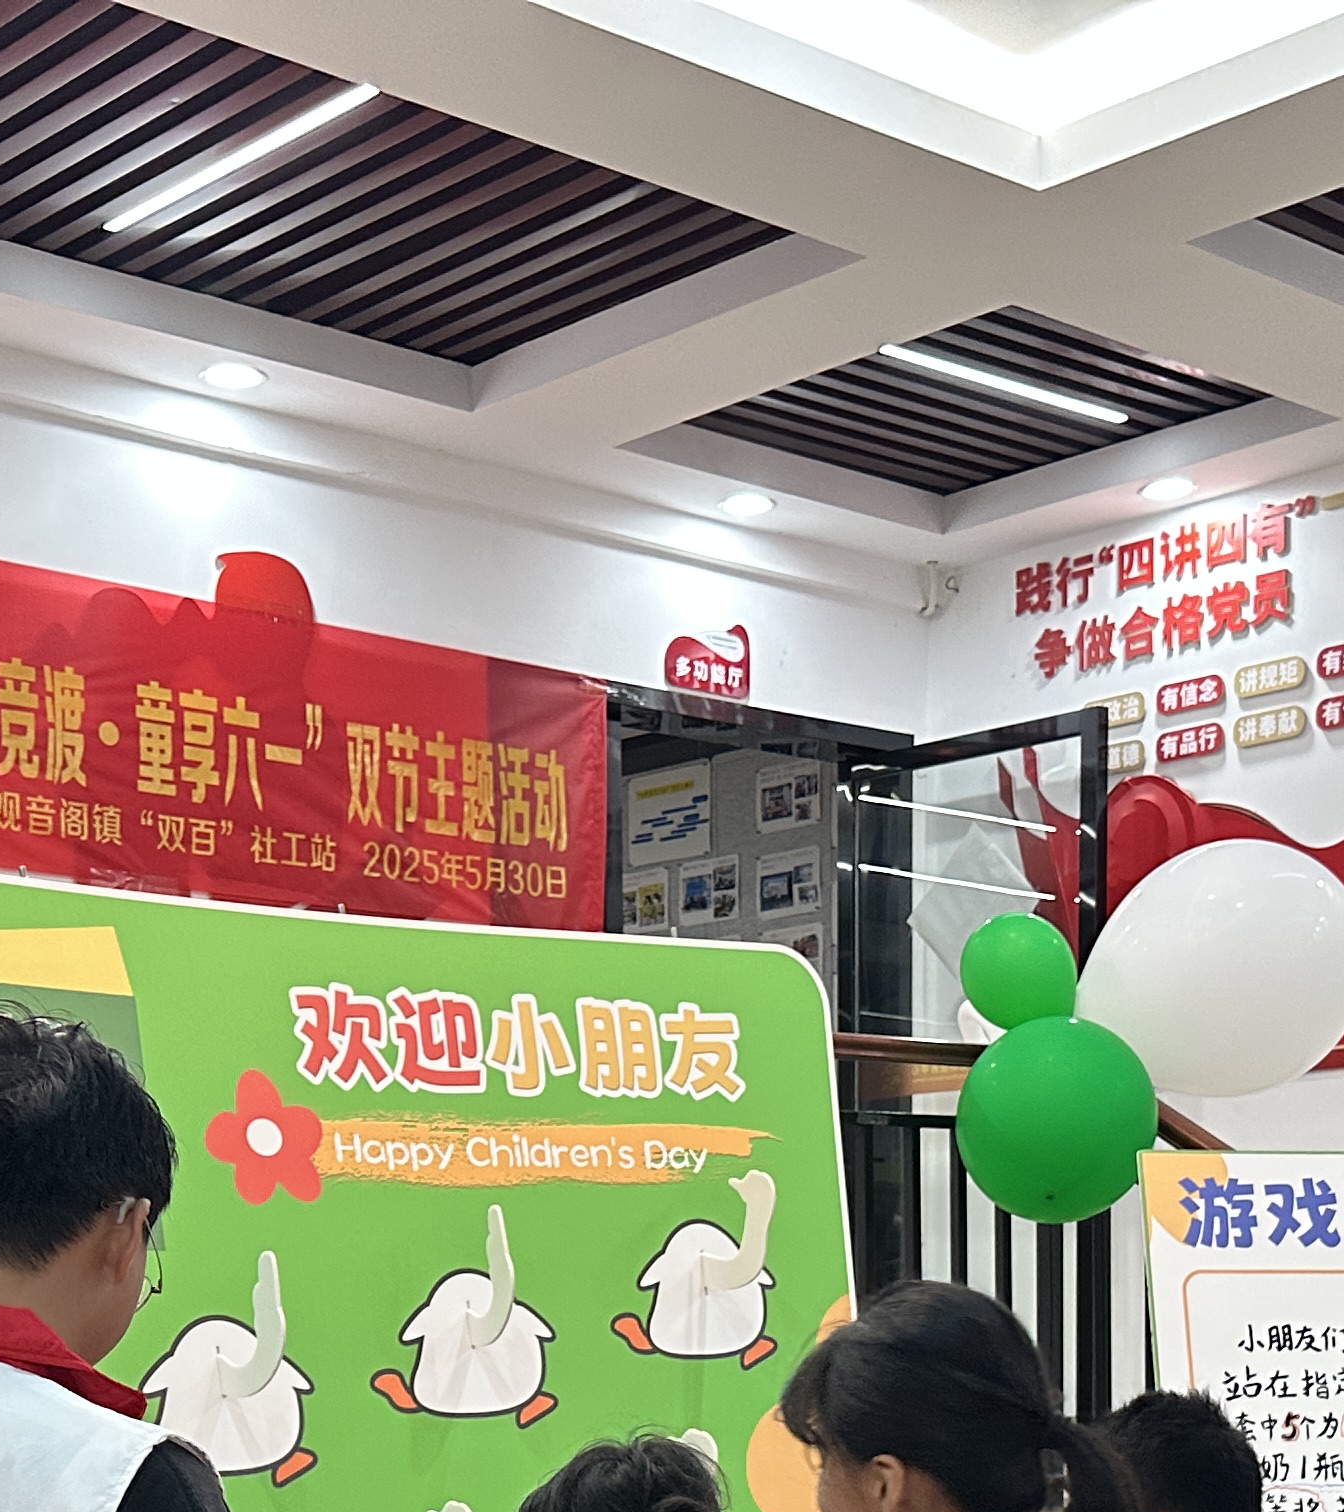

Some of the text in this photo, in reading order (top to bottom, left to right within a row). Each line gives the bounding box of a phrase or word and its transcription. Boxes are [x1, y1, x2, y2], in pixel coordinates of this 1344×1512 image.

[1015, 495, 1317, 617] 践行“四讲四有”
[1034, 569, 1293, 678] 争做合格党员
[674, 655, 744, 690] 多功能厅
[1160, 679, 1219, 712] 有信念
[1239, 661, 1298, 694] 讲规矩
[1160, 728, 1218, 760] 有品行
[1238, 710, 1298, 743] 讲奉献
[362, 842, 567, 898] 2025年5月30日
[290, 983, 744, 1100] 欢迎小朋友
[334, 1132, 708, 1173] Happy Children's Day
